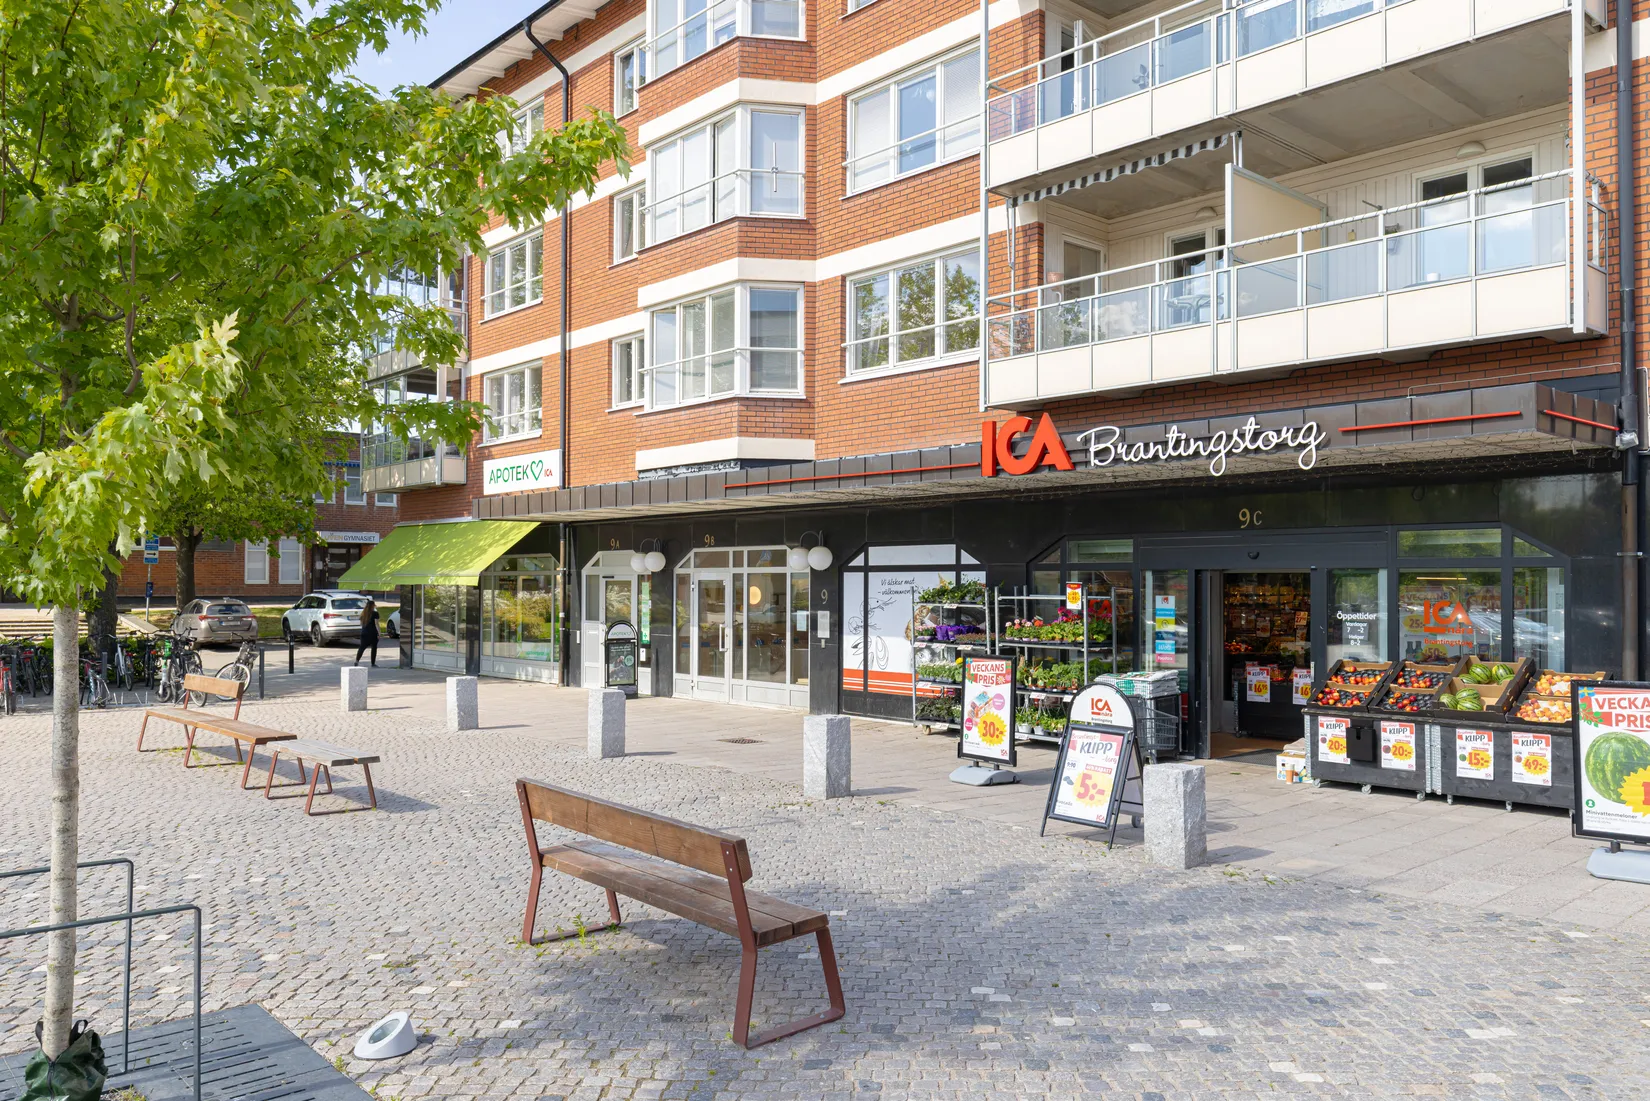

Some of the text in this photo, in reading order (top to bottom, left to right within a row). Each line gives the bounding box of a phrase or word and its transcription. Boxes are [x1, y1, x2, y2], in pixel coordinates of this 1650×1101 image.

[981, 413, 1327, 477] ICA Brantingstorg
[489, 465, 553, 484] APOTEK ICA
[821, 589, 828, 604] 9
[1337, 611, 1377, 620] Öppettider
[1424, 600, 1473, 625] ICA
[1424, 638, 1474, 649] Brantingstorg
[972, 663, 1004, 673] VECKANS
[978, 674, 995, 685] PRIS
[1091, 697, 1112, 712] ICA
[982, 720, 1004, 739] 30:-
[1389, 727, 1408, 735] KLIPP
[1080, 741, 1113, 755] KLIPP
[1391, 745, 1411, 757] 20:-
[1468, 752, 1490, 766] 15:-
[1524, 759, 1547, 771] 49:-
[1077, 773, 1105, 801] 5:-
[1586, 810, 1637, 819] Minivattenmeloner
